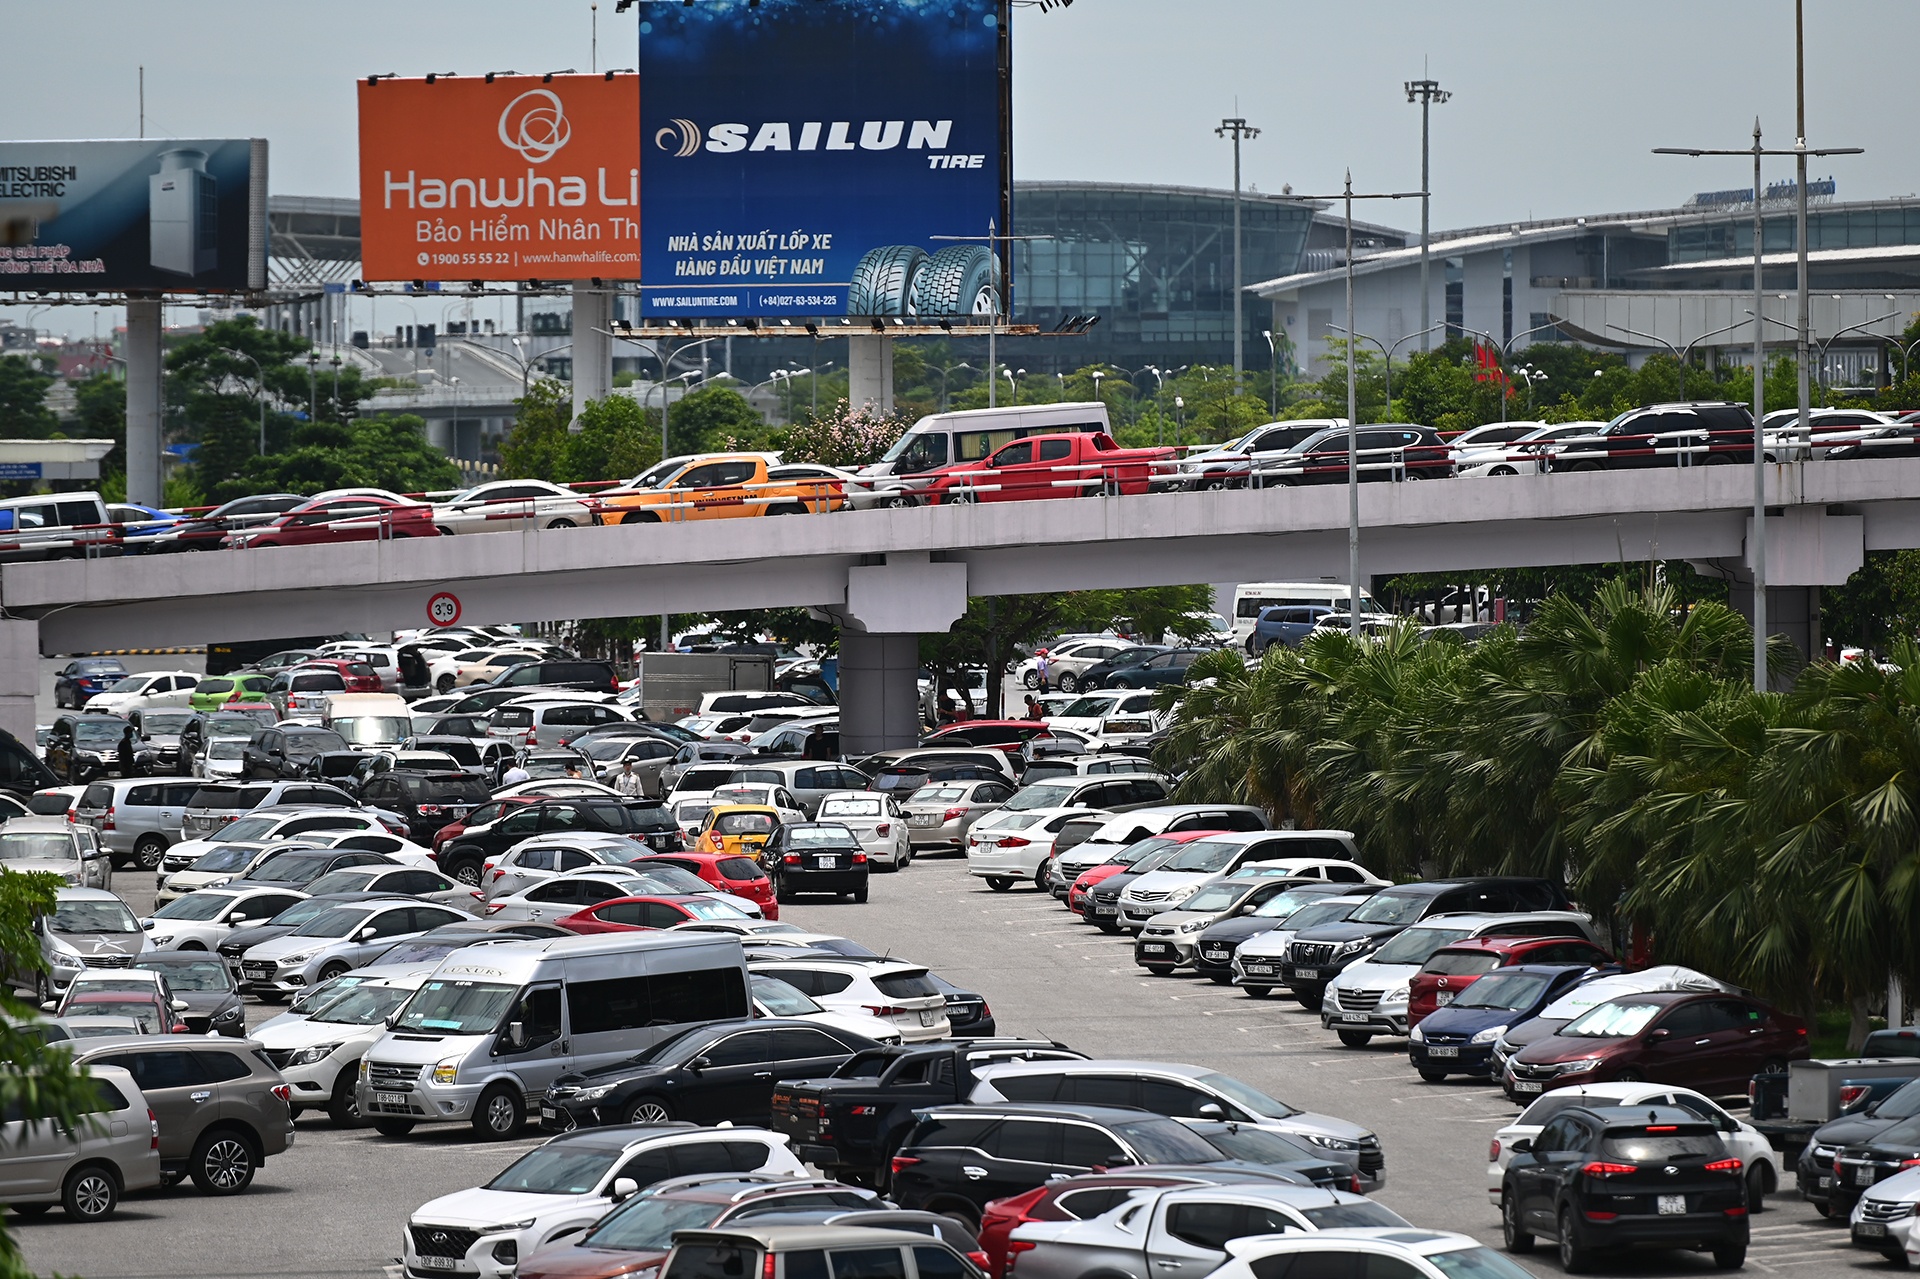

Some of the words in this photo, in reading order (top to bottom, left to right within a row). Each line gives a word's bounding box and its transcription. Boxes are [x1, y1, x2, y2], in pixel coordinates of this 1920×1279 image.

[705, 119, 953, 153] SAILUN
[927, 154, 986, 169] TIRE
[0, 183, 65, 197] LECTRIC
[384, 167, 587, 209] Hanwha
[416, 217, 462, 243] Bảo
[470, 213, 530, 241] Hiểm
[539, 219, 601, 240] Nhân
[668, 231, 699, 252] NHÀ
[702, 230, 734, 251] SẢN
[736, 229, 777, 251] XUẤT
[779, 229, 809, 250] LỐP
[812, 234, 832, 250] XE
[432, 253, 460, 265] 1900
[462, 253, 476, 264] 55
[478, 253, 493, 264] 55
[495, 253, 510, 264] 22
[523, 250, 641, 263] www.hanwhalife.com.
[675, 257, 717, 276] HÀNG
[719, 253, 751, 275] ĐẦU
[754, 256, 788, 279] VIỆT
[790, 258, 824, 275] NAM
[652, 296, 738, 307] WWW.SAILUNTIRE.COM
[443, 967, 508, 977] LUXURY
